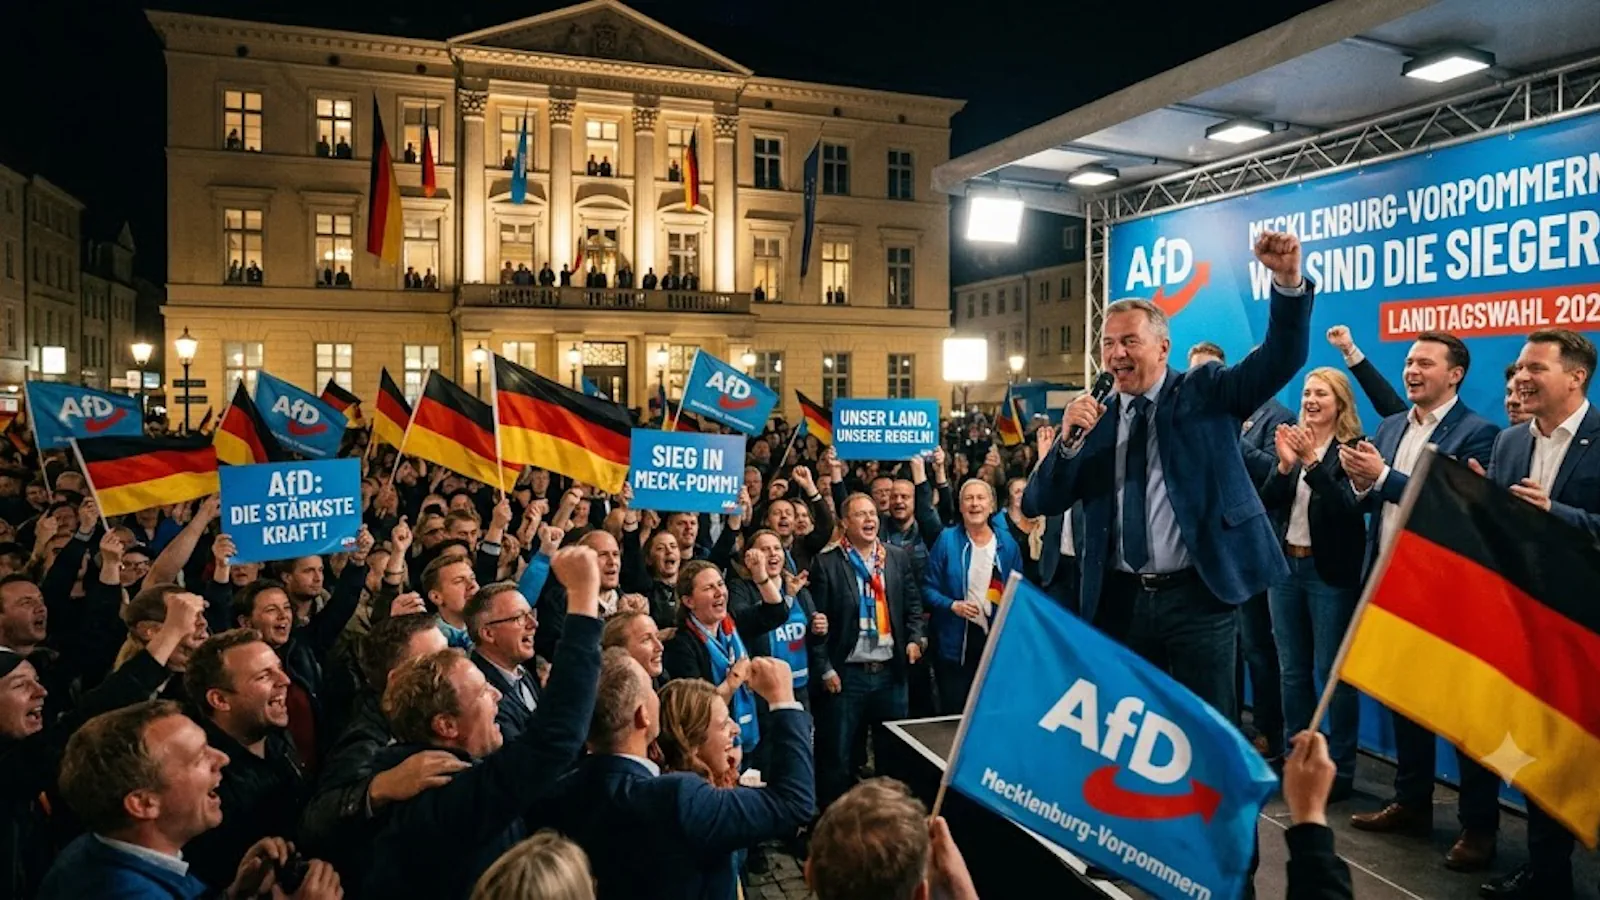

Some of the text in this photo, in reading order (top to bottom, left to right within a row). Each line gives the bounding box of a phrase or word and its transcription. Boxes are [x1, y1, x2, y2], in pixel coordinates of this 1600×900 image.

[1125, 236, 1193, 291] AfD
[1306, 244, 1375, 294] SIND
[1384, 233, 1437, 288] DIE
[1388, 297, 1550, 334] LANDTAGSWAHL
[704, 370, 751, 399] AfD
[59, 395, 113, 422] AfD
[271, 395, 319, 425] AfD
[840, 409, 931, 429] UNSER LAND,
[836, 429, 934, 444] UNSERE REGELN!
[651, 444, 723, 471] SIEG IN
[268, 469, 323, 497] AfD:
[635, 470, 738, 494] MECK-POMM!
[230, 496, 355, 525] DIE STÄRKSTE
[262, 521, 327, 545] KRAFT!
[1038, 678, 1192, 784] AfD
[980, 767, 1212, 900] Mecklenburg-Vorpommern
